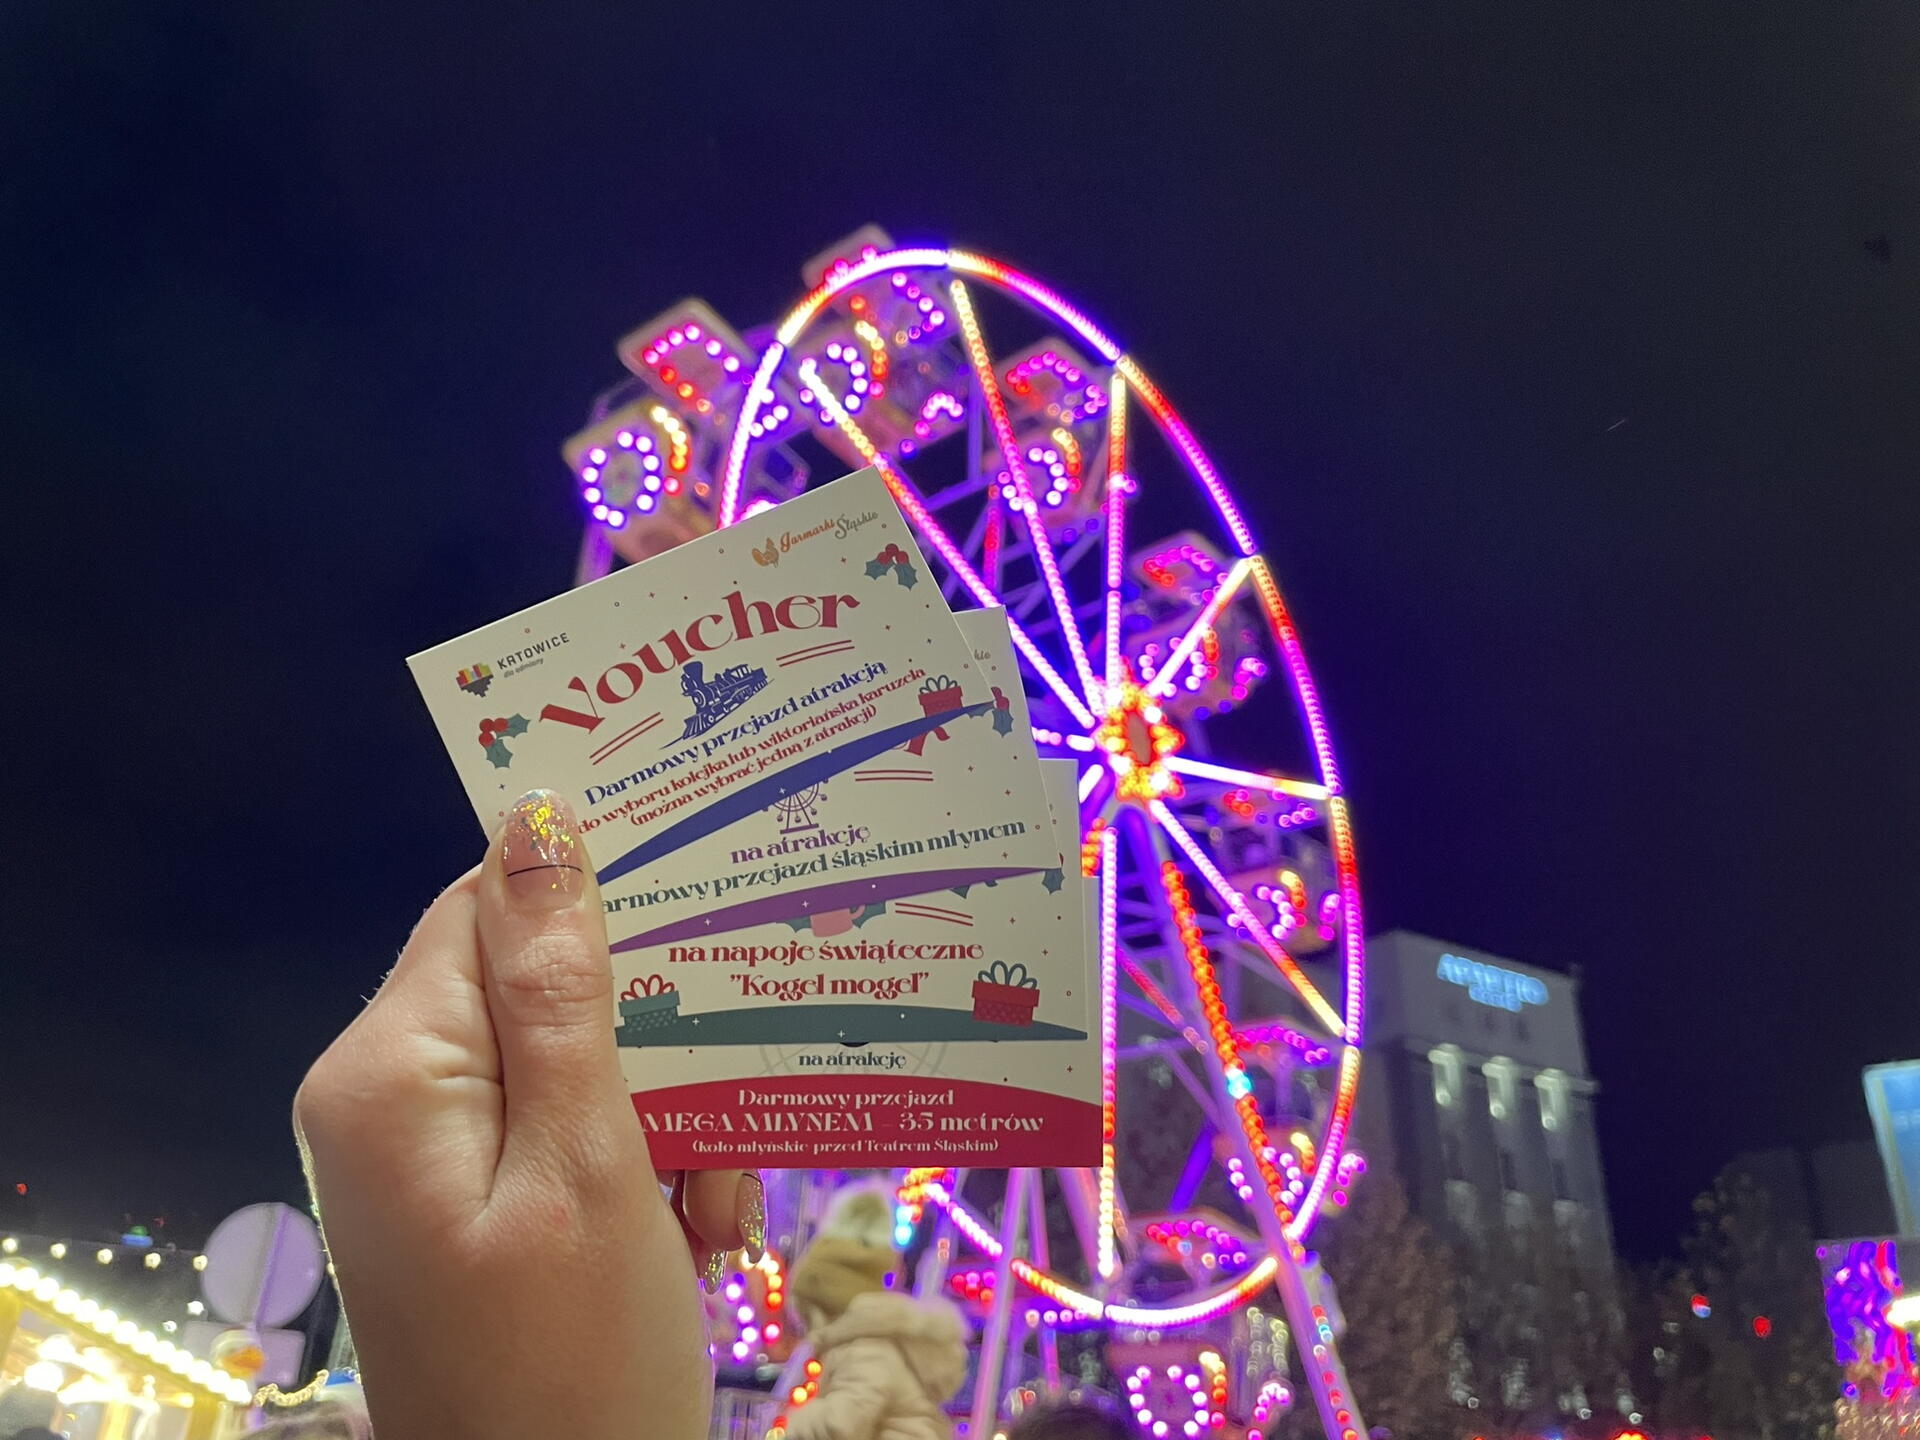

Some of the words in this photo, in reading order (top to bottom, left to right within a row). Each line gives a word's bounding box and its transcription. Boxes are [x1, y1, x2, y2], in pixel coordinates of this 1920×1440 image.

[780, 519, 835, 552] Jarmarki
[497, 632, 569, 670] KATOWICE
[539, 590, 860, 734] Voucher
[578, 819, 600, 834] do
[602, 786, 670, 822] wyboru
[671, 758, 728, 791] kolejka
[728, 746, 757, 765] lub
[755, 700, 859, 750] wiktoriańska
[858, 669, 926, 704] karuzela
[584, 746, 698, 805] Darmowy
[702, 697, 799, 756] przejazd
[800, 662, 888, 707] atrakcją
[630, 794, 693, 826] (można
[694, 761, 755, 796] wybrać
[755, 742, 803, 773] jedną
[803, 738, 815, 749] z
[815, 704, 877, 742] atrakcji)
[731, 846, 764, 864] na
[767, 824, 871, 857] atrakcję
[602, 881, 708, 913] armowy
[712, 853, 828, 897] przejazd
[831, 839, 923, 868] śląskim
[667, 947, 706, 963] na
[711, 941, 814, 967] napoje
[819, 939, 984, 964] świąteczne
[799, 1054, 823, 1066] na
[827, 1052, 907, 1069] atrakcję
[738, 1089, 850, 1109] Darmowy
[855, 1089, 954, 1109] przejazd
[643, 1112, 734, 1132] MEGA
[900, 1112, 934, 1132] 35
[940, 1113, 1044, 1132] metrów
[813, 1140, 862, 1155] przed
[864, 1139, 931, 1152] Teatrem
